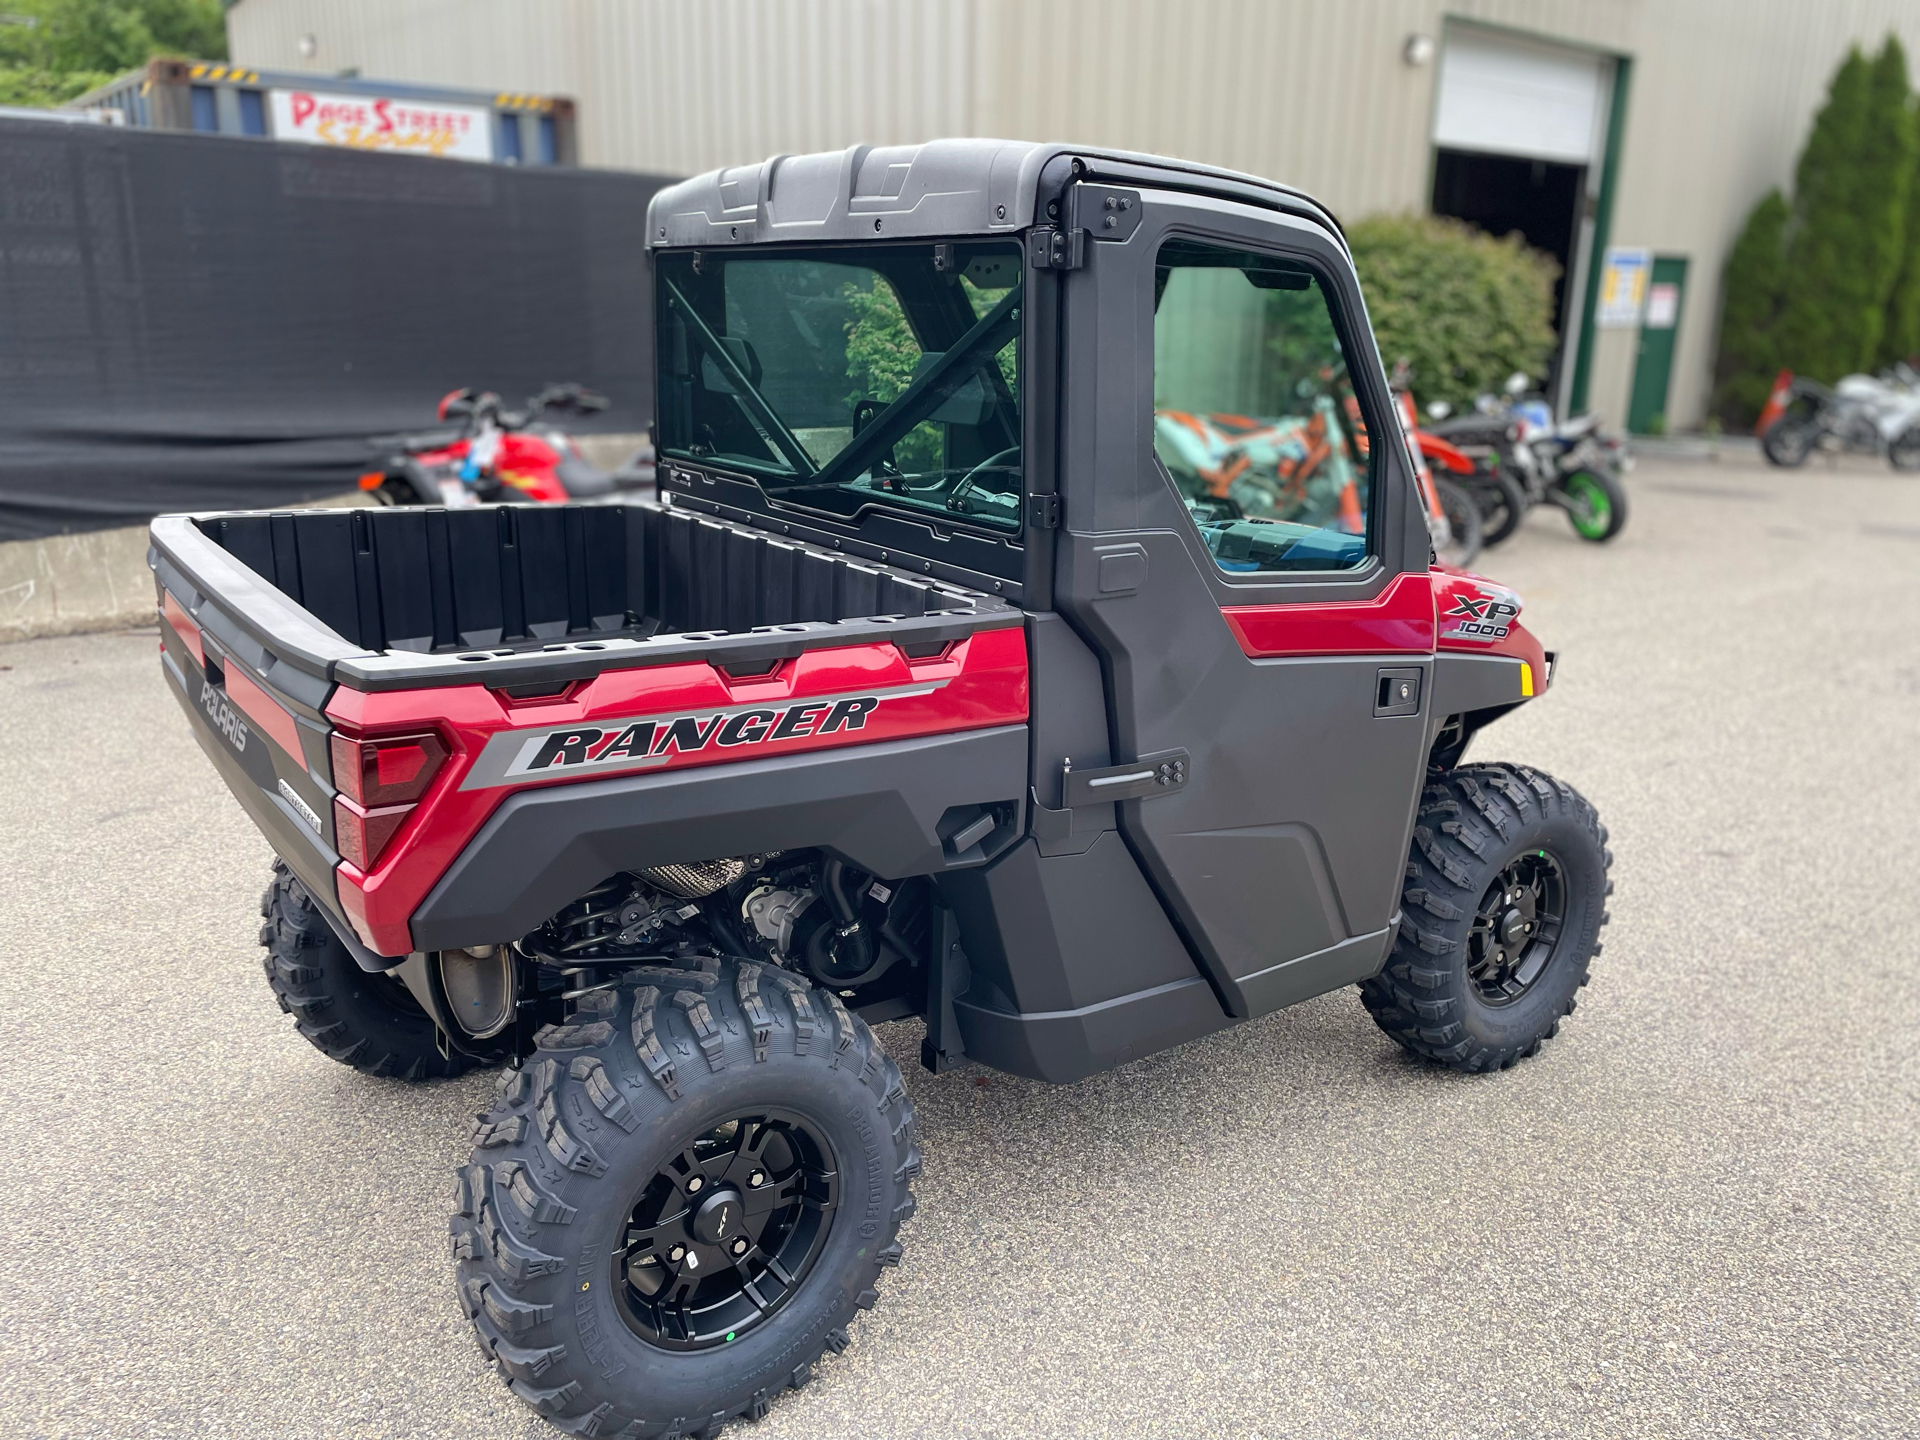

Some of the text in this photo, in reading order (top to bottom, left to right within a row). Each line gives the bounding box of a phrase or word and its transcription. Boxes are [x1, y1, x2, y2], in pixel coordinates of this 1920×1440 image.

[290, 91, 471, 132] PAGE STREET
[1443, 593, 1519, 620] XP
[1459, 621, 1509, 638] 1000
[200, 681, 248, 752] POLARIS
[526, 696, 879, 770] RANGER
[846, 1105, 883, 1217] PRO ARMOR
[575, 1243, 626, 1386] X-TERRAIN
